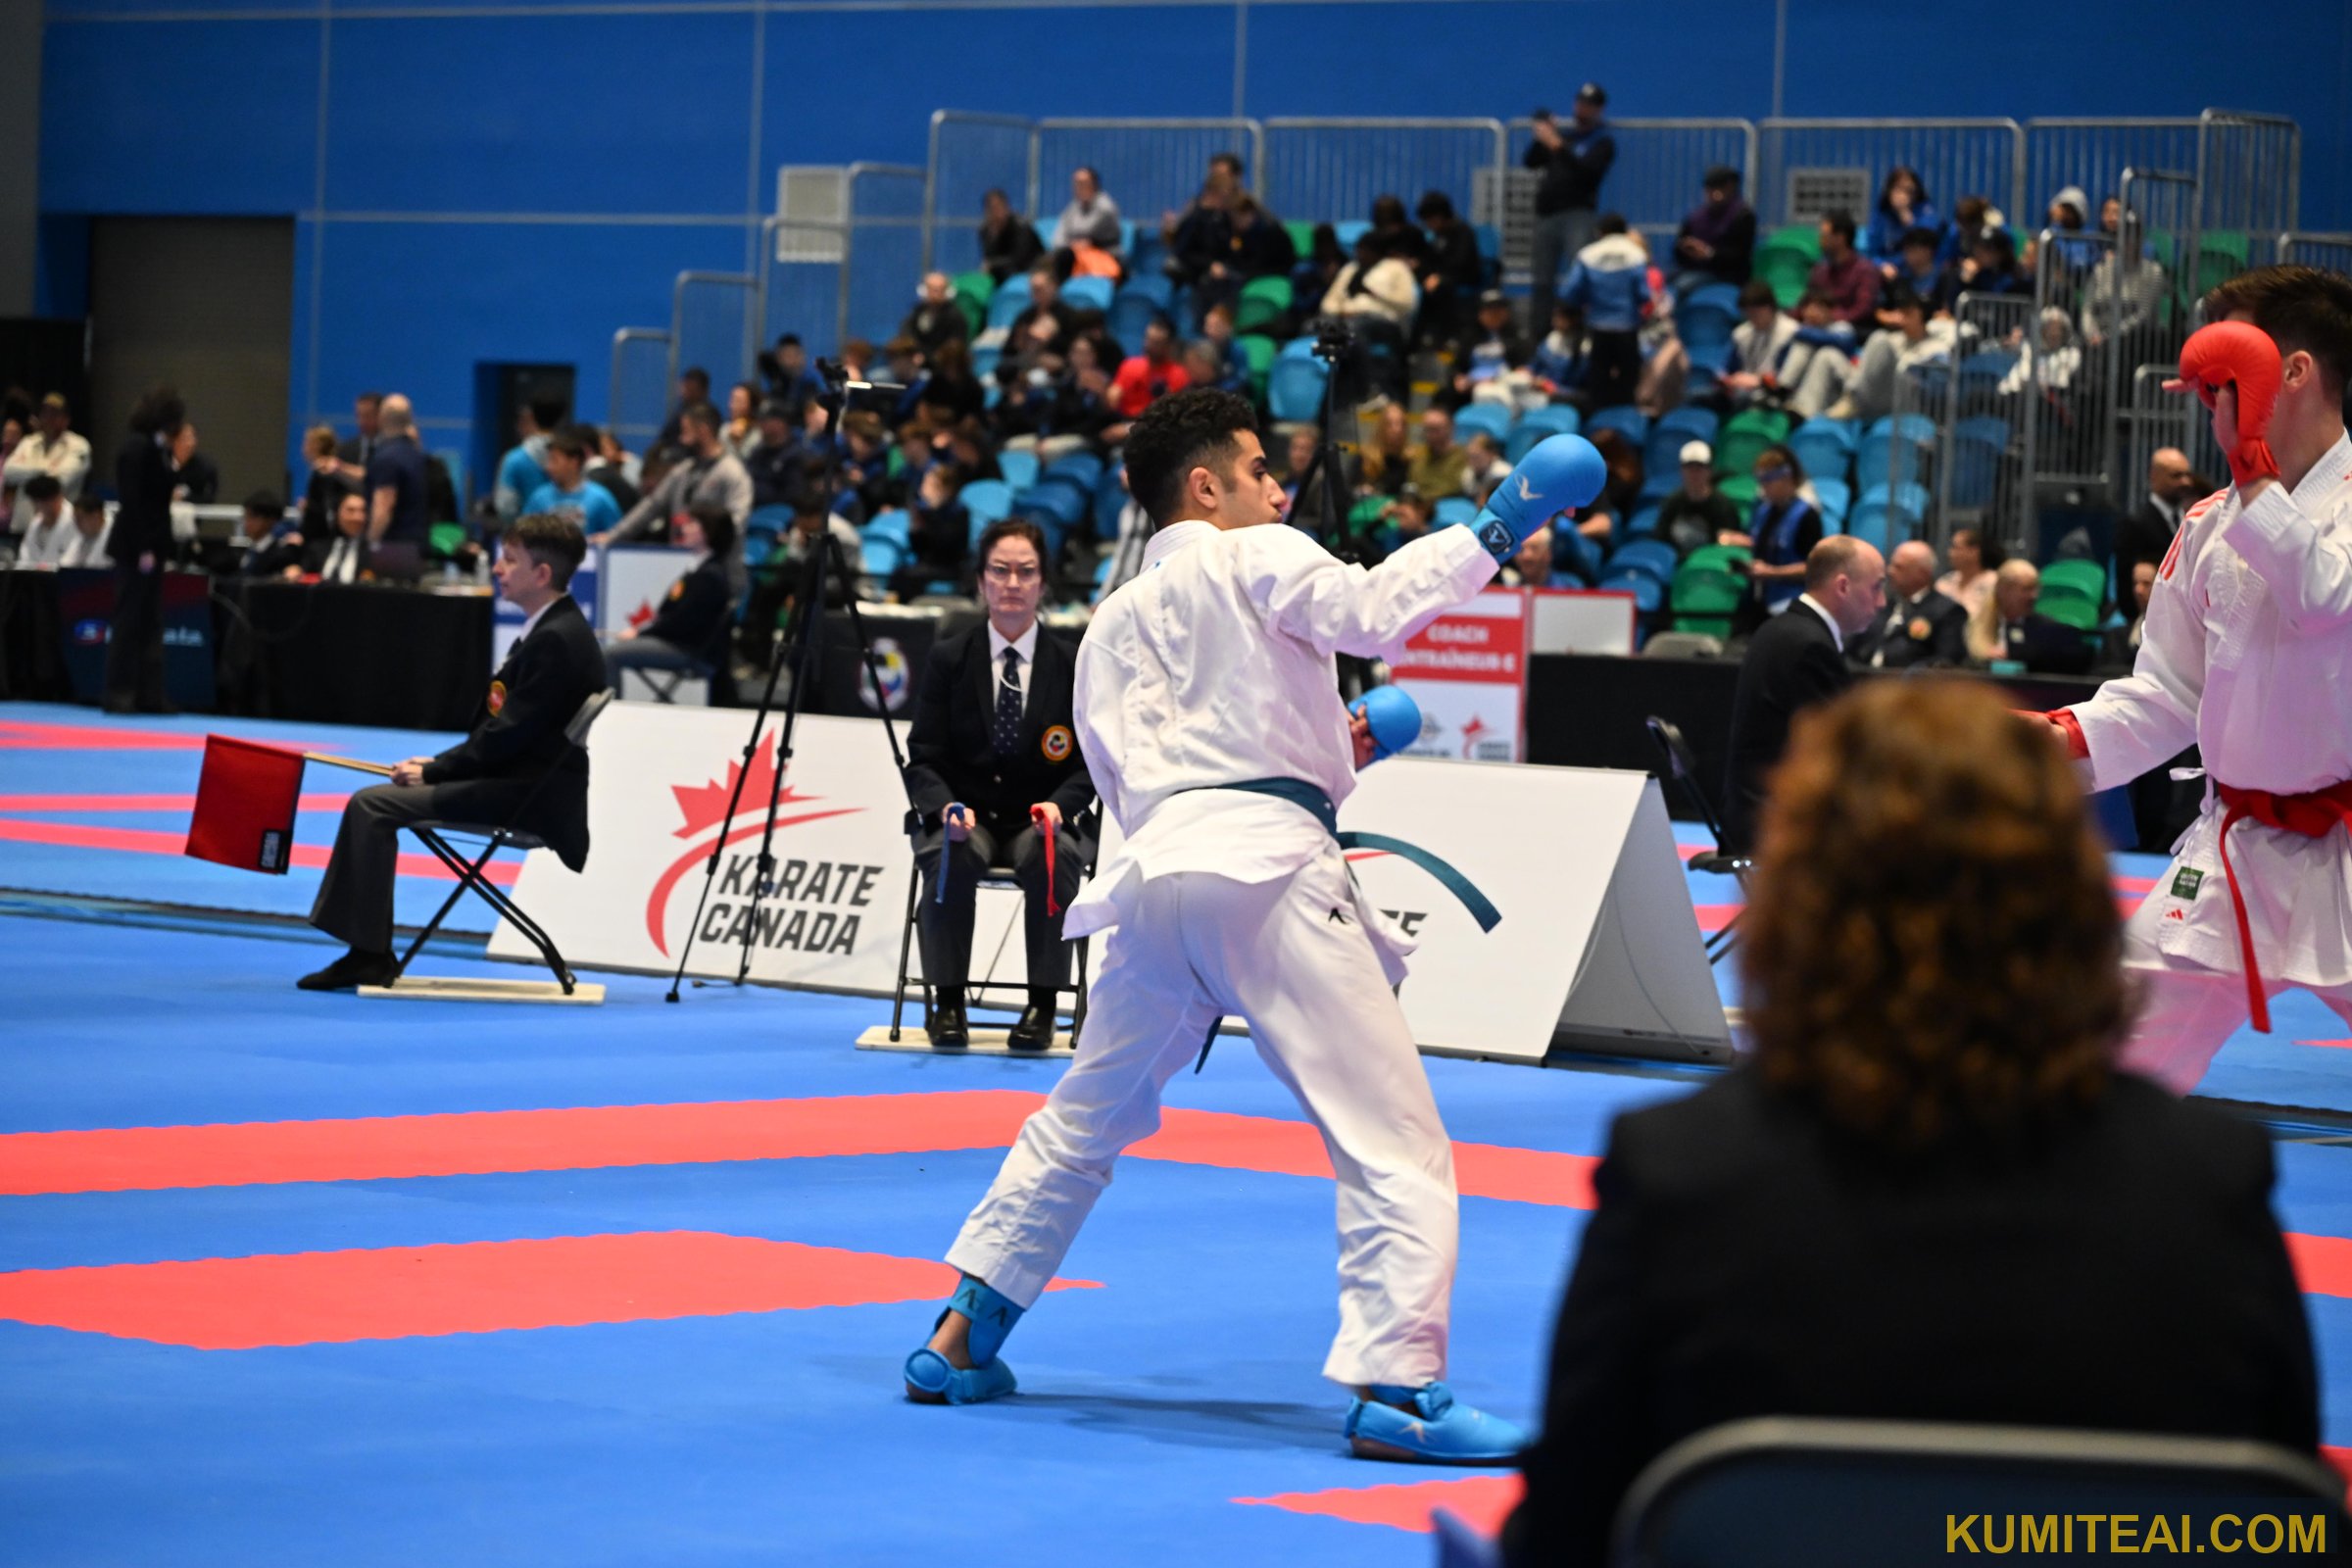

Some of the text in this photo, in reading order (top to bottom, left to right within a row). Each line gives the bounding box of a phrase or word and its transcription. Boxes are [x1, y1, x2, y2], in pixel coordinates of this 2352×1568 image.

[1427, 623, 1490, 644] COACH
[718, 855, 885, 906] KARATE
[700, 903, 861, 956] CANADA
